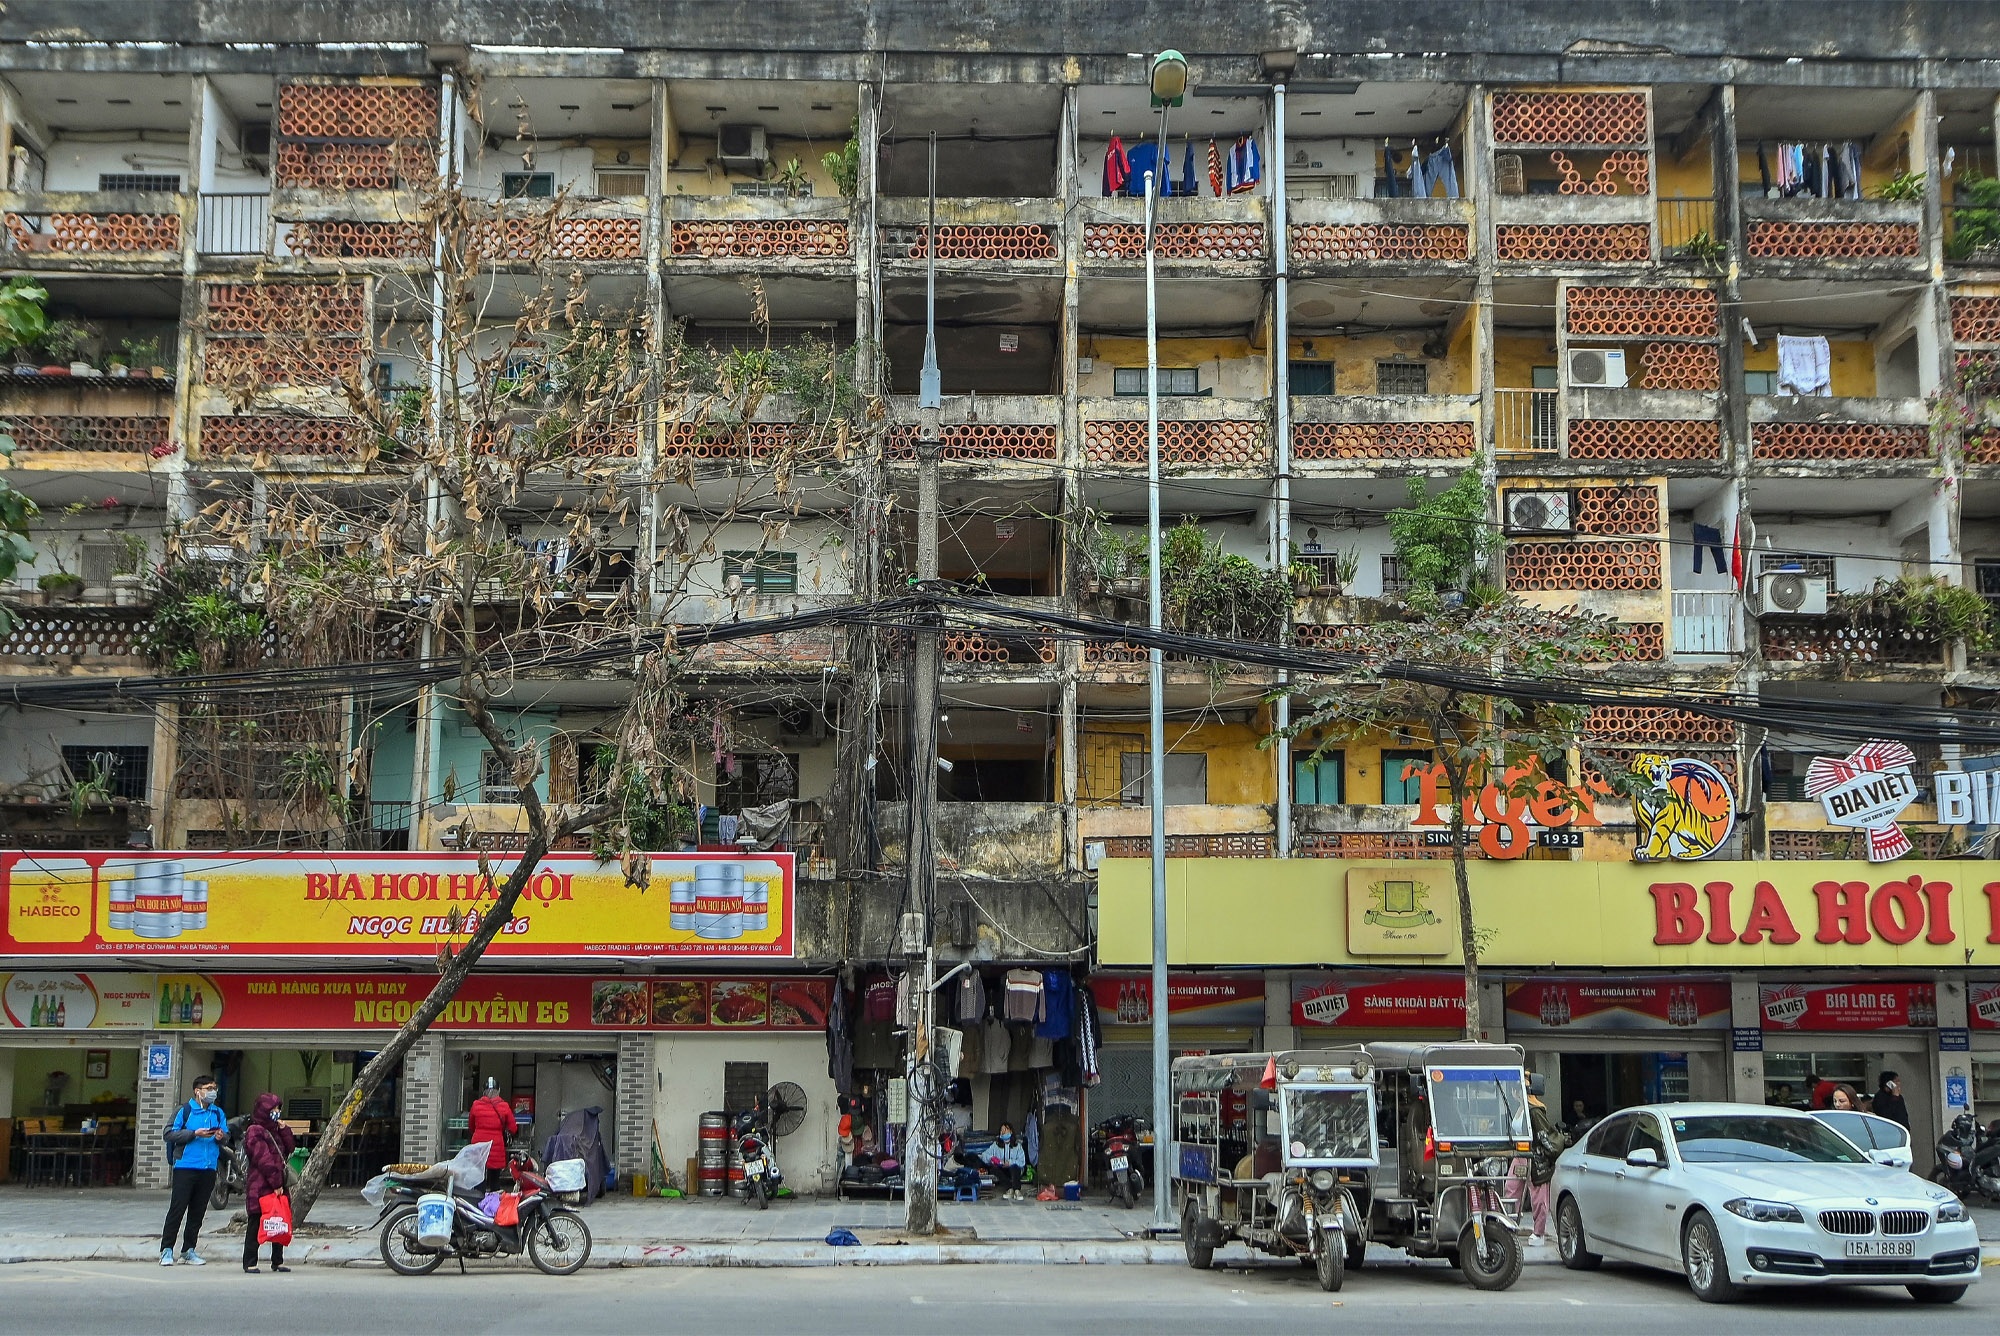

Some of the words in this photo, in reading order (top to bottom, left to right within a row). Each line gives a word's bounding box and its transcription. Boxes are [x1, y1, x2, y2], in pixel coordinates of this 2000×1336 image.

[1829, 788, 1869, 819] BIA
[1864, 772, 1910, 802] VIỆT
[1933, 770, 2000, 825] BI
[1543, 833, 1579, 845] 1932
[304, 873, 367, 901] BIA
[371, 871, 440, 901] HƠI
[20, 905, 81, 917] HABECO
[1648, 880, 1801, 946] BIA
[1812, 874, 1957, 946] HƠI
[348, 915, 413, 938] NGỌC
[247, 980, 277, 994] NHÀ
[281, 980, 320, 994] HÀNG
[323, 982, 352, 994] XƯA
[355, 980, 374, 994] VÀ
[377, 982, 407, 995] NAY
[103, 992, 124, 1001] NGỌC
[1394, 995, 1427, 1008] KHOÁI
[1430, 994, 1450, 1008] BẤT
[1452, 995, 1466, 1010] TẬ
[1826, 993, 1848, 1009] BIA
[1880, 993, 1896, 1008] E6
[536, 1001, 569, 1023] E6
[1305, 1000, 1323, 1016] BIA
[1321, 996, 1346, 1012] VIỆT
[1767, 1004, 1786, 1018] BIA
[1784, 998, 1804, 1013] VIỆT
[1979, 1001, 1996, 1016] BIA
[1480, 1031, 1488, 1040] 10
[1850, 1241, 1913, 1255] 15A-188.89
